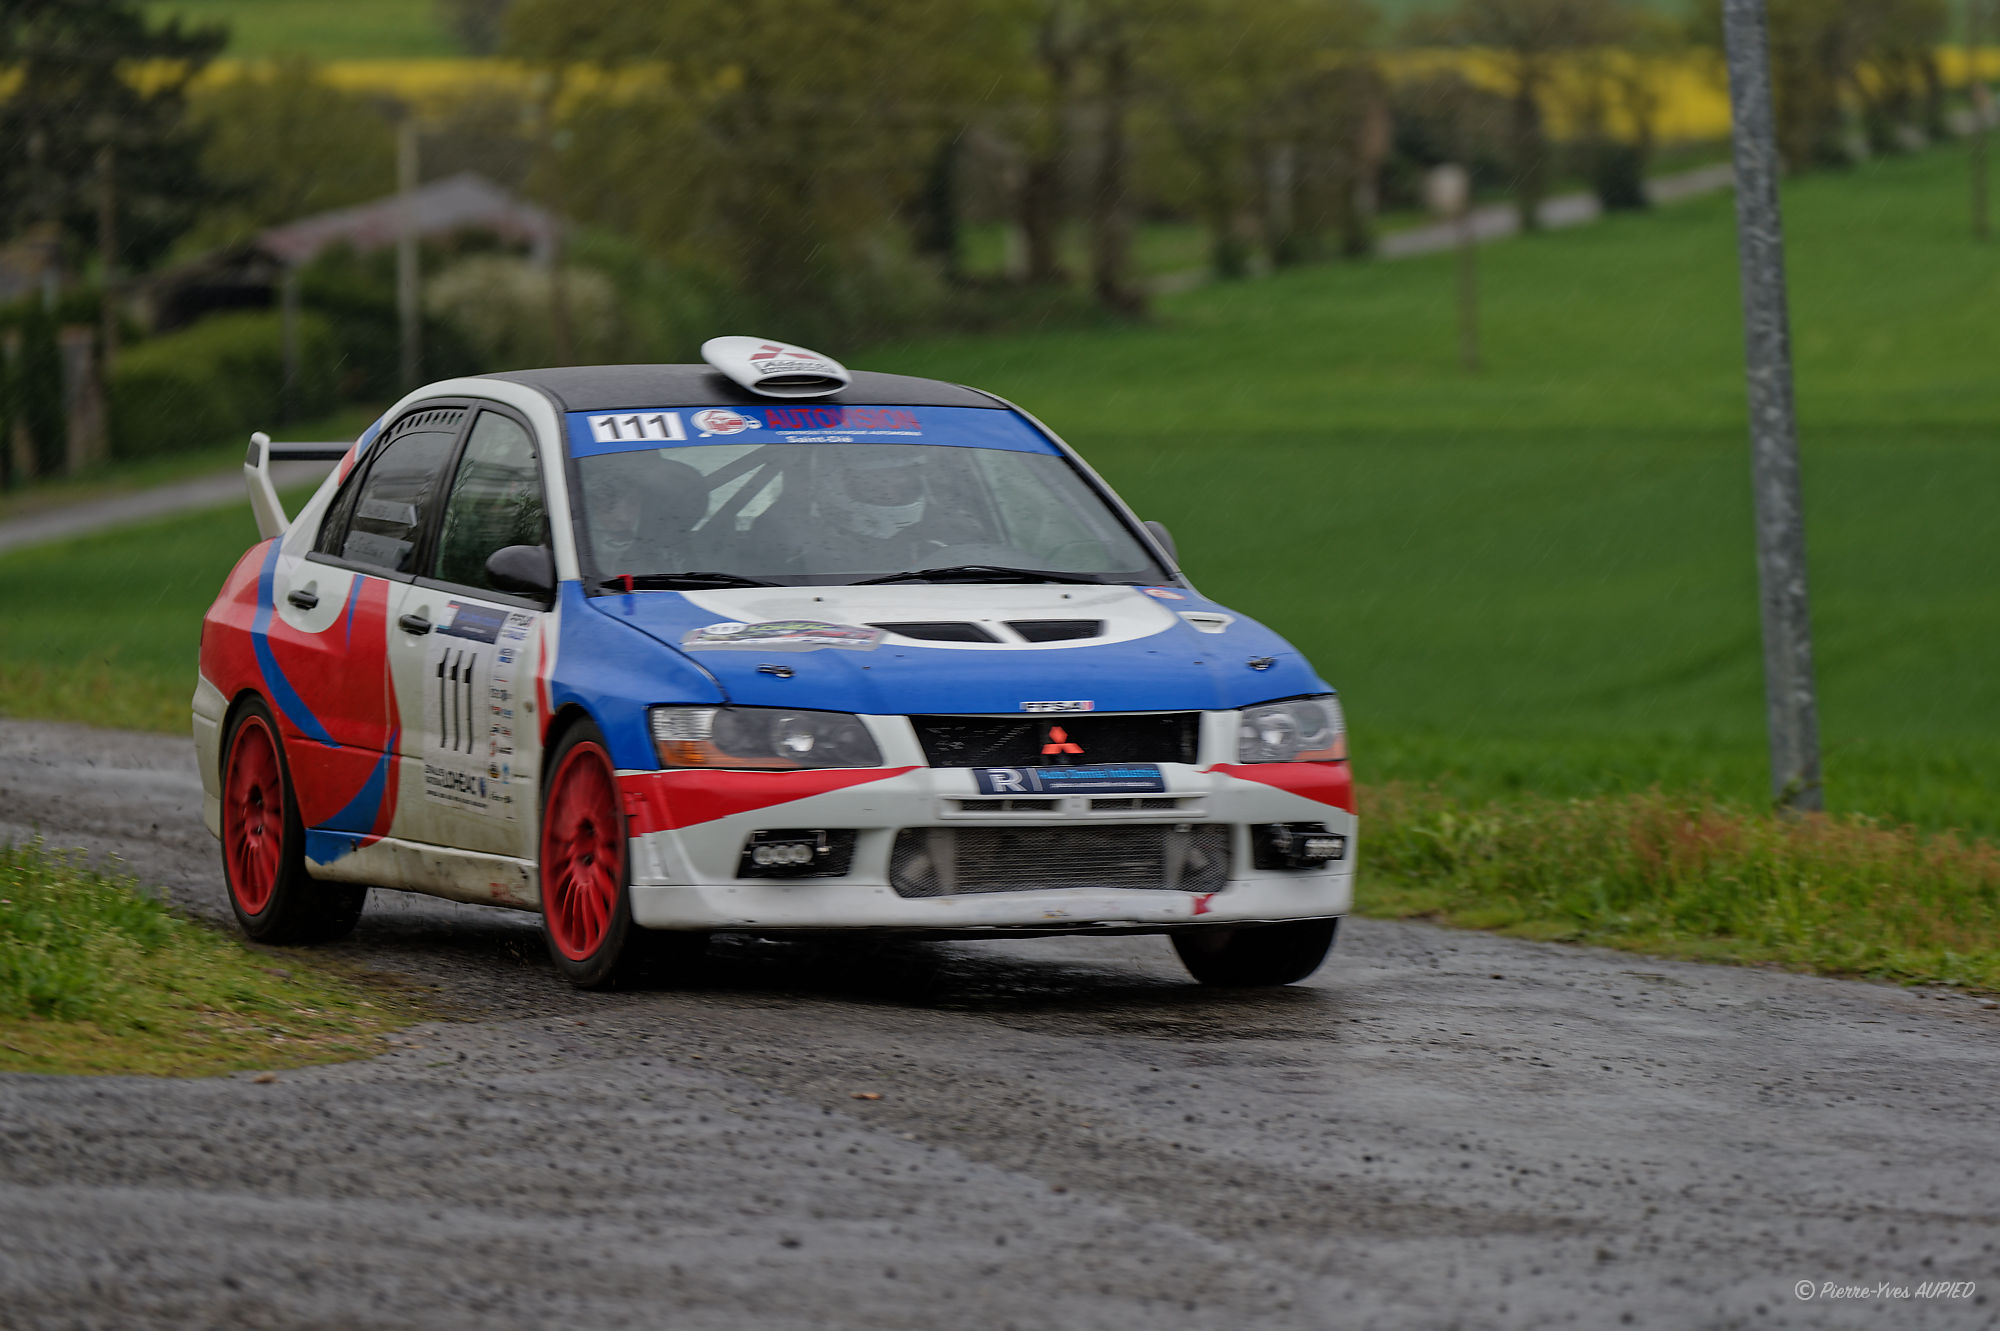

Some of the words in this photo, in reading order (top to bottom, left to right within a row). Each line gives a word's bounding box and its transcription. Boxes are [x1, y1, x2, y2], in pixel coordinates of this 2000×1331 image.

[600, 415, 672, 439] 111
[765, 408, 922, 430] AUTOVISION
[437, 648, 477, 755] 111
[986, 768, 1027, 792] R
